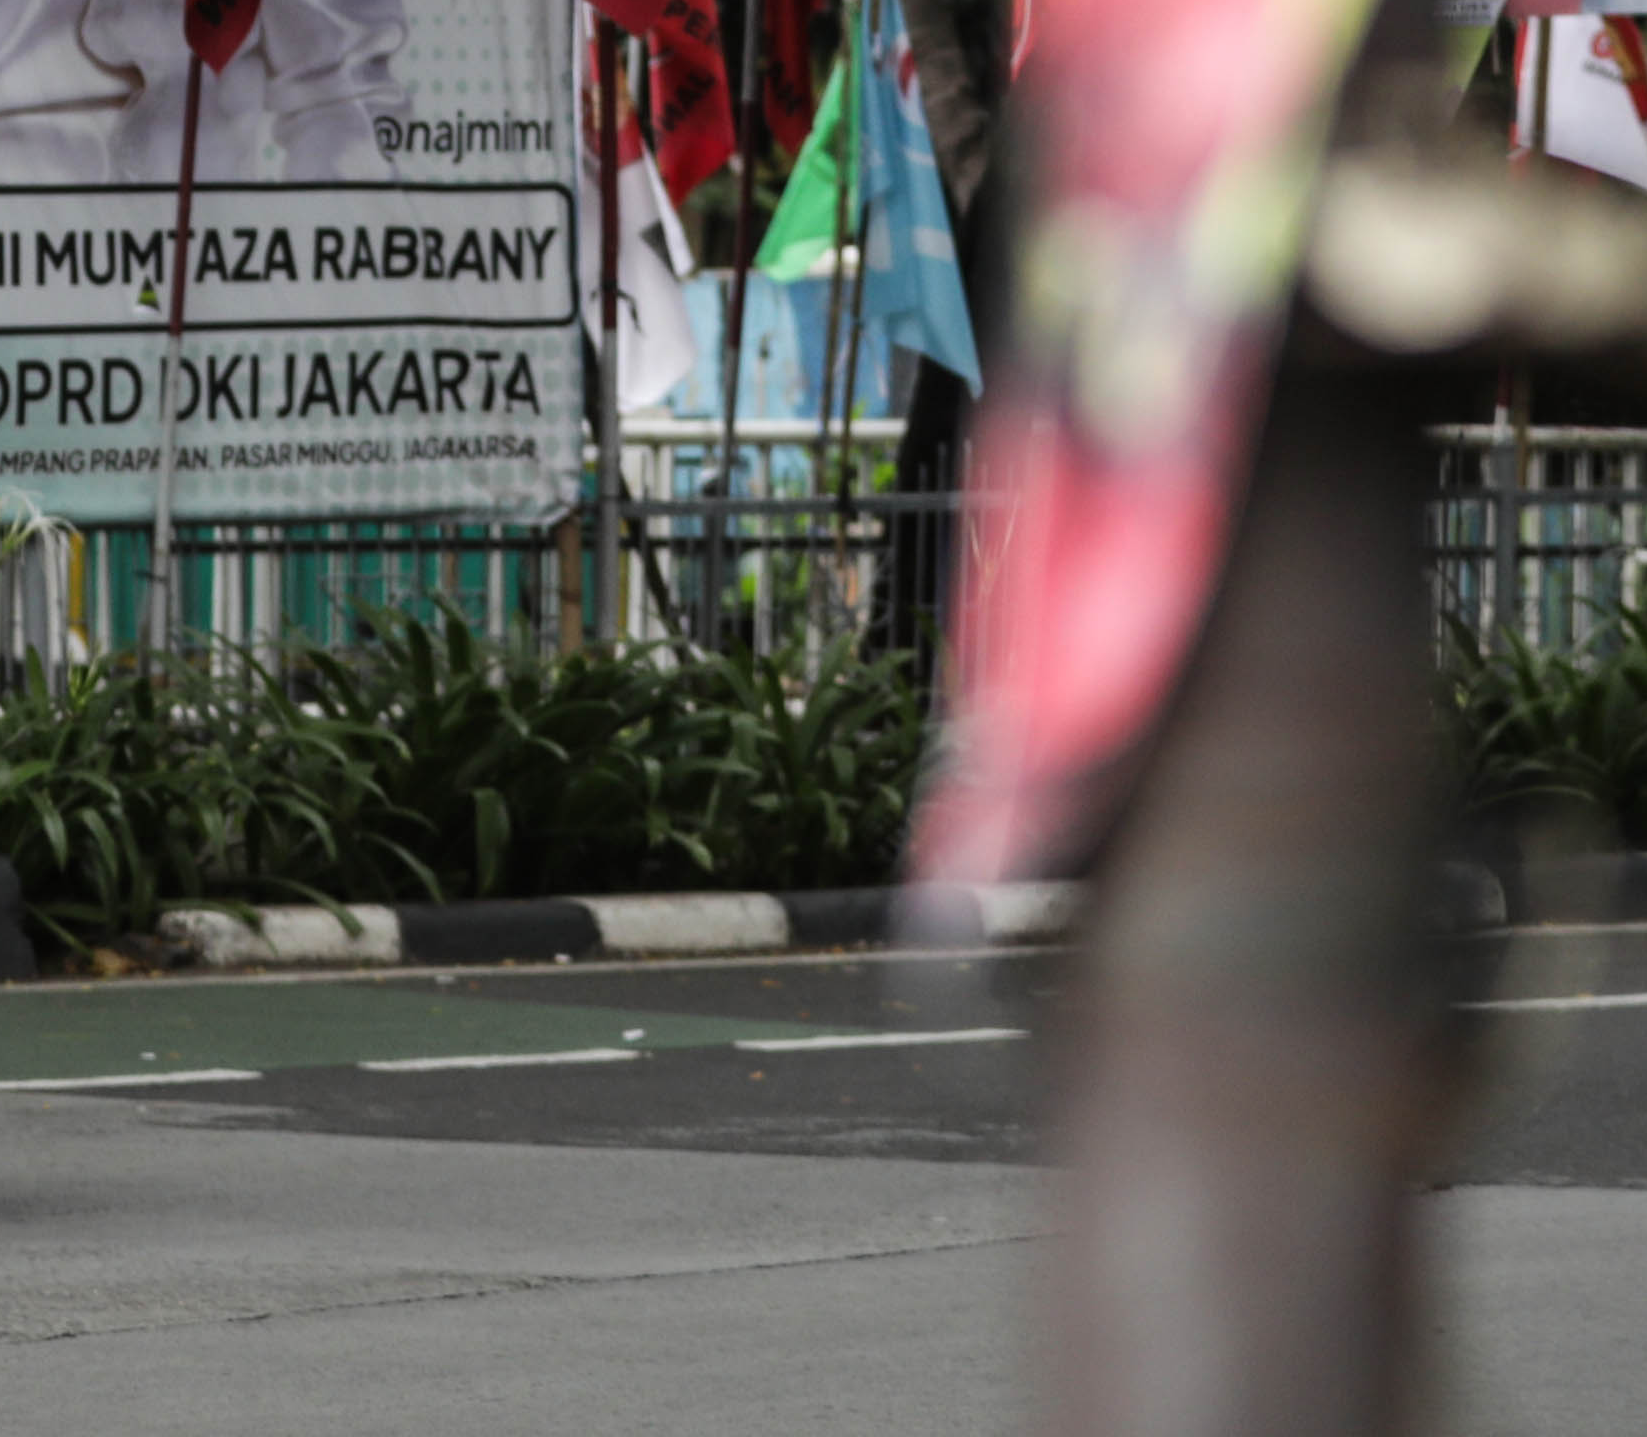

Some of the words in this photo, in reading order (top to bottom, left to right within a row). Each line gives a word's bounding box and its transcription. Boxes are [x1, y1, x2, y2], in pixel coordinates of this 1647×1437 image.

[314, 225, 556, 282] RABBANY
[158, 353, 261, 424] DKI
[277, 347, 541, 420] JAKARTA
[220, 442, 292, 471] PASAR
